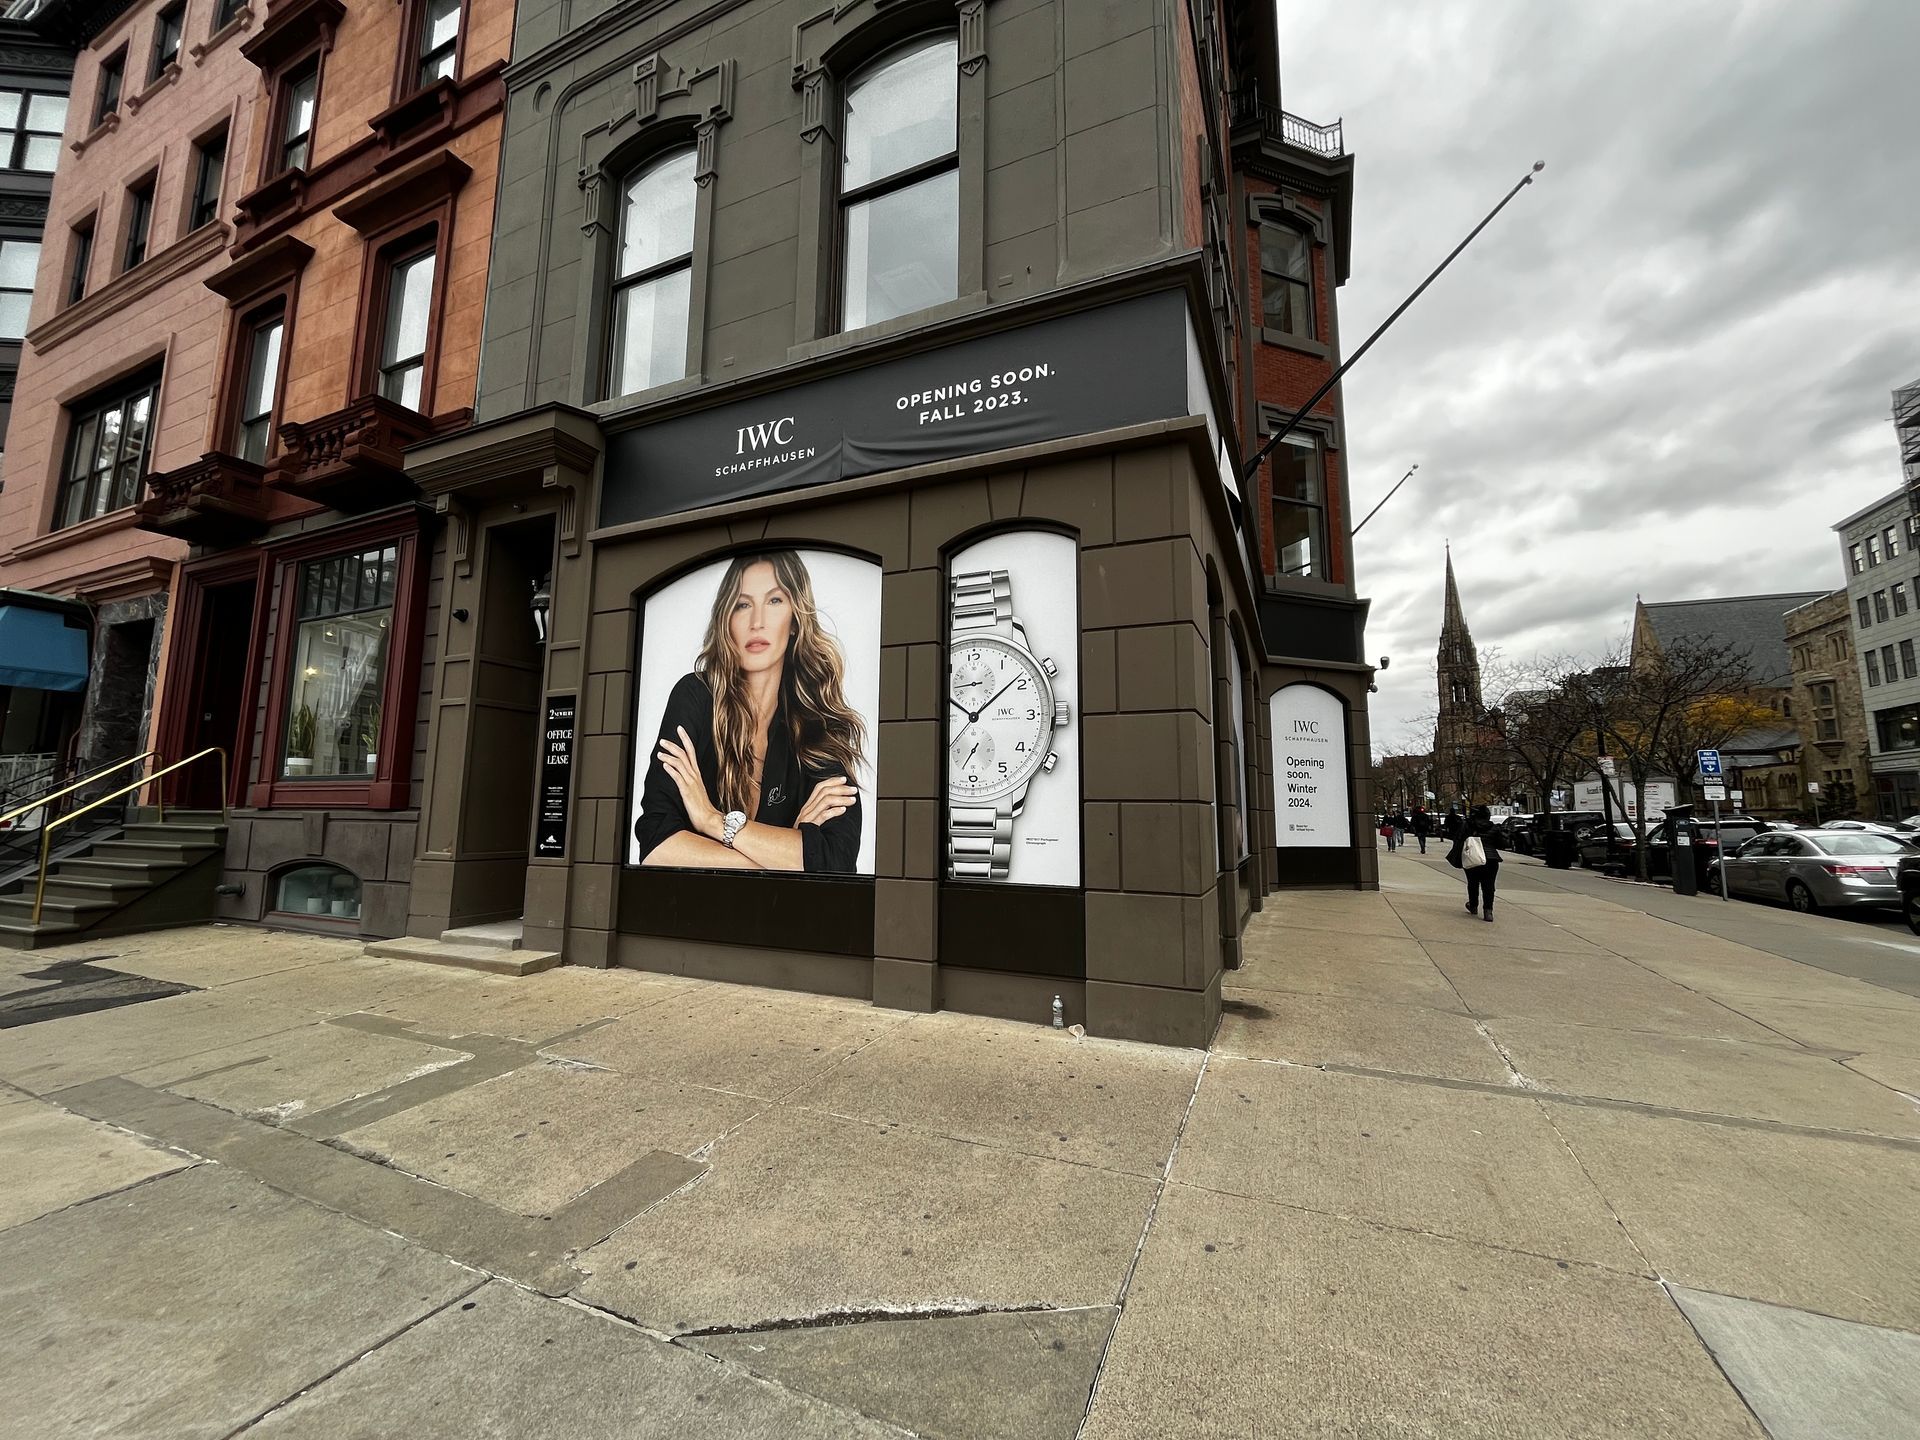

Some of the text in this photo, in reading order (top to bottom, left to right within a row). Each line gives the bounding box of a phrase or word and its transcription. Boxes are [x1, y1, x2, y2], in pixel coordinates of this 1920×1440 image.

[896, 363, 1056, 410] OPENING SOON.
[919, 390, 1029, 425] FALL 2023.
[735, 416, 795, 455] IWC
[715, 447, 816, 477] SCHAFFHAUSEN
[1017, 679, 1027, 690] 2
[998, 707, 1015, 716] IWC
[1026, 708, 1036, 721] 3
[1293, 720, 1319, 734] IWC
[547, 730, 573, 739] OFFICE
[552, 742, 566, 752] FOR
[1014, 741, 1026, 753] 4
[547, 755, 569, 764] LEASE
[1286, 756, 1325, 770] Opening
[998, 762, 1008, 774] 5
[1286, 770, 1312, 780] soon.
[1287, 783, 1318, 794] Winter
[1288, 797, 1313, 808] 2024.
